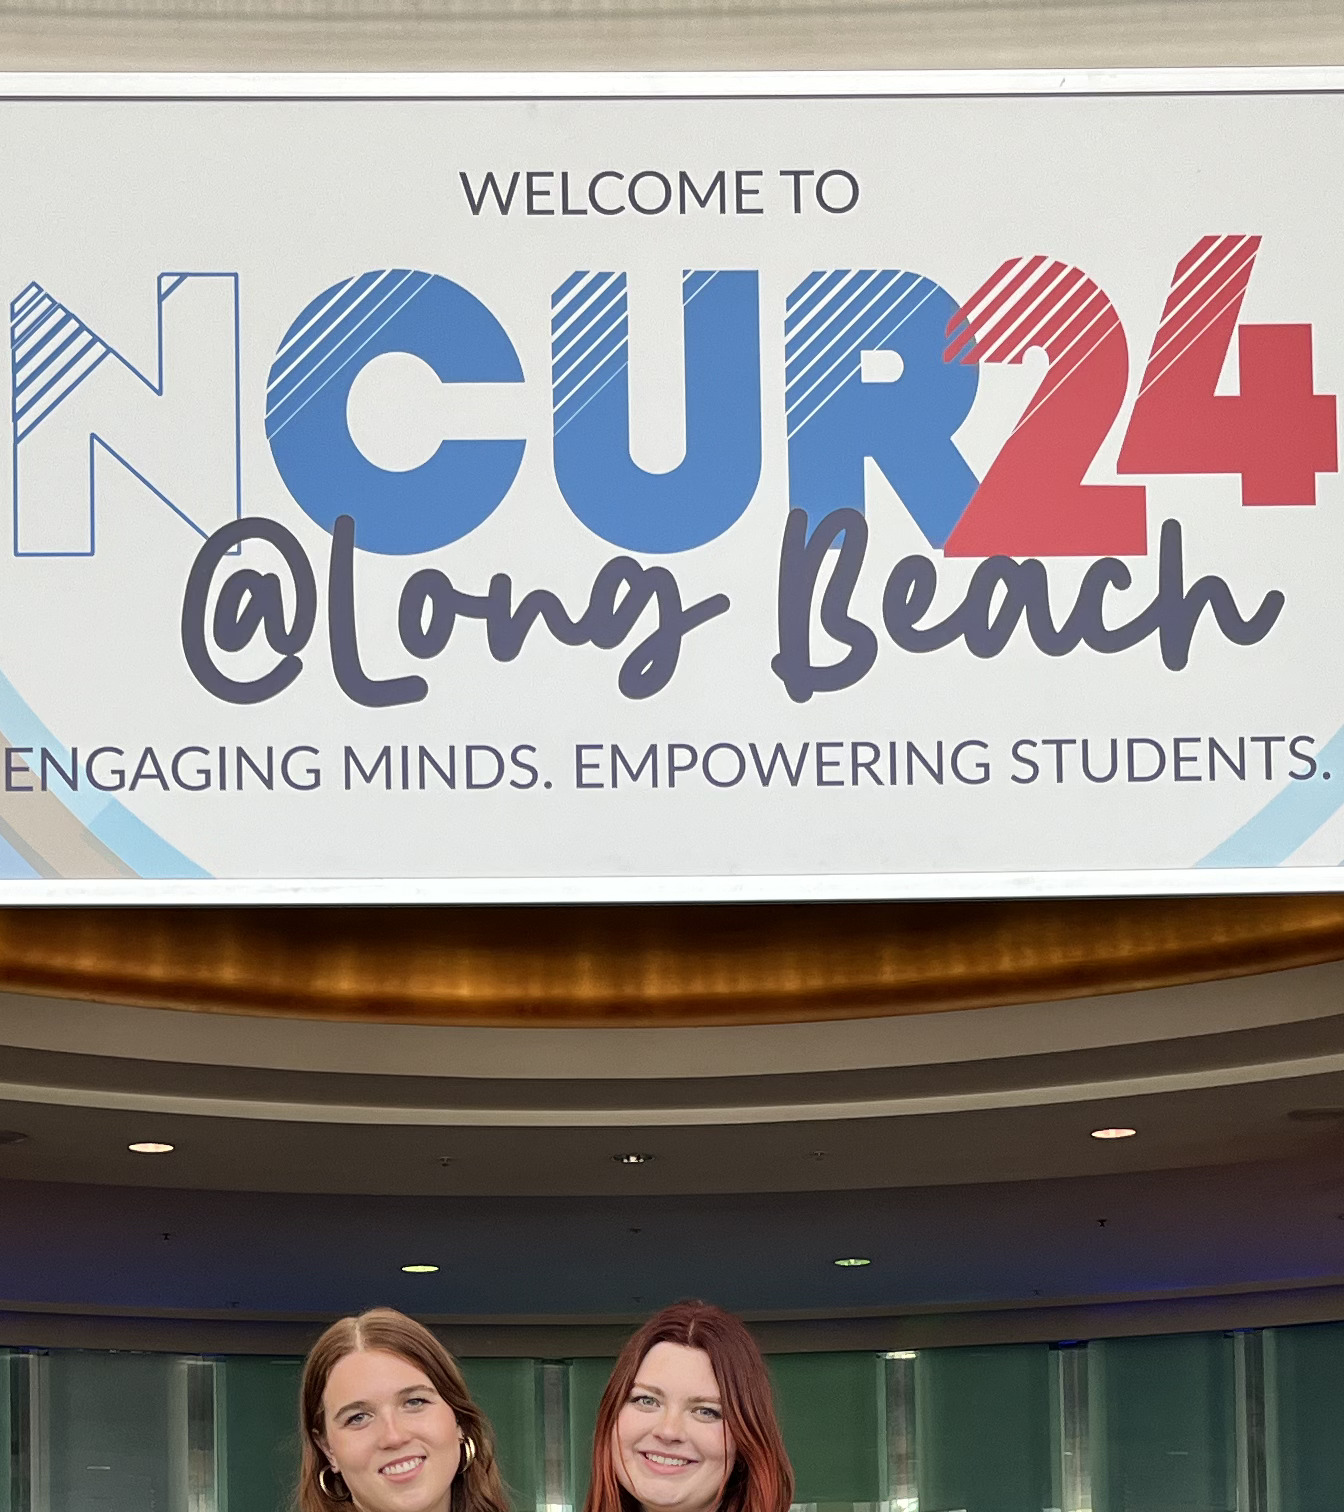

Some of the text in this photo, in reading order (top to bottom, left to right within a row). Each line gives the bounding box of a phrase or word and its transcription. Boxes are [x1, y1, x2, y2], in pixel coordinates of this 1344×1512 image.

[459, 169, 860, 216] WELCOME TO
[10, 234, 1339, 558] NCUR24
[181, 507, 1285, 708] @Long Beach
[4, 734, 1332, 793] ENGAGING MINDS. EMPOWERING STUDENTS.
